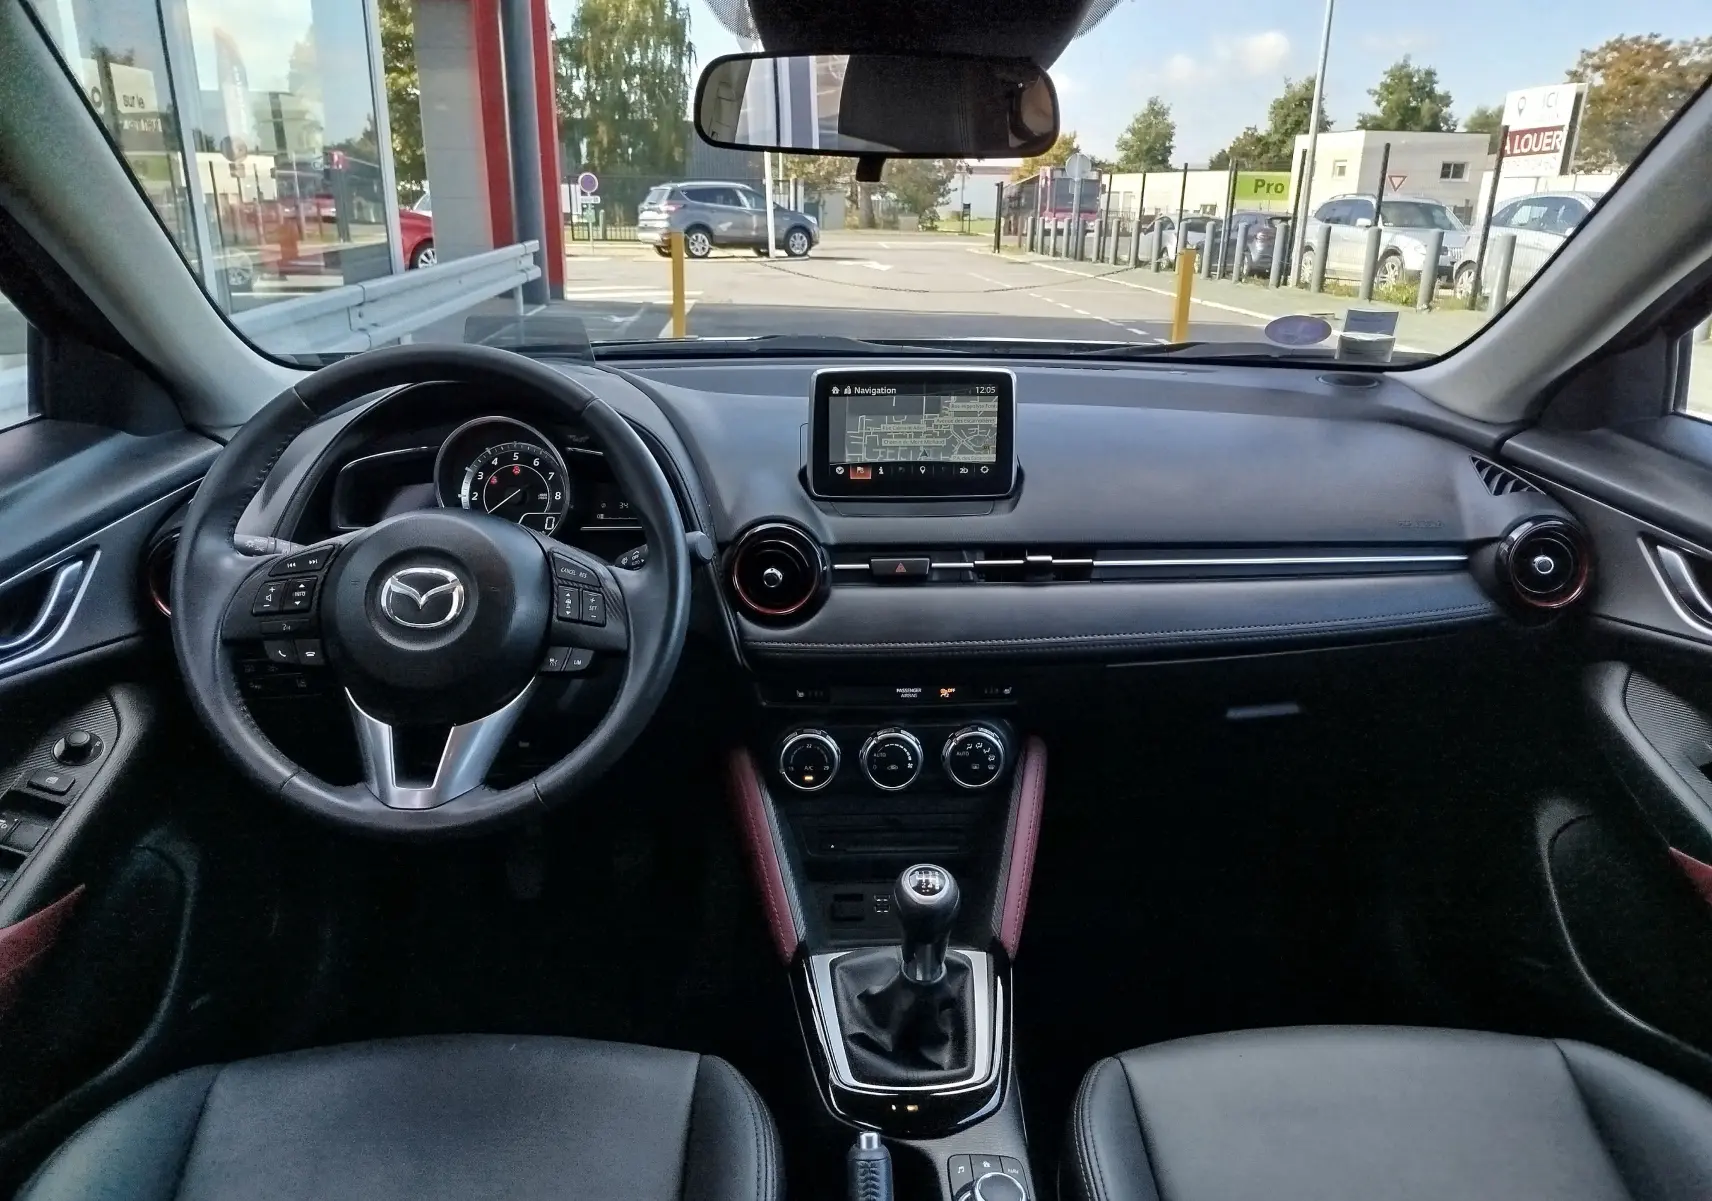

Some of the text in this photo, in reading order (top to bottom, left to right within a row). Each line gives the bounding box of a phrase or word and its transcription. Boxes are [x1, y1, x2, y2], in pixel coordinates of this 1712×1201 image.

[1513, 131, 1562, 153] LOUER
[1253, 178, 1285, 194] Pro
[854, 386, 897, 396] Navigation
[975, 386, 996, 394] 12:05
[513, 452, 519, 461] 5
[491, 457, 498, 466] 4
[533, 458, 540, 466] 6
[477, 471, 484, 480] 3
[548, 471, 555, 480] 7
[471, 492, 479, 501] 2
[554, 491, 561, 500] 8
[544, 516, 556, 530] 0
